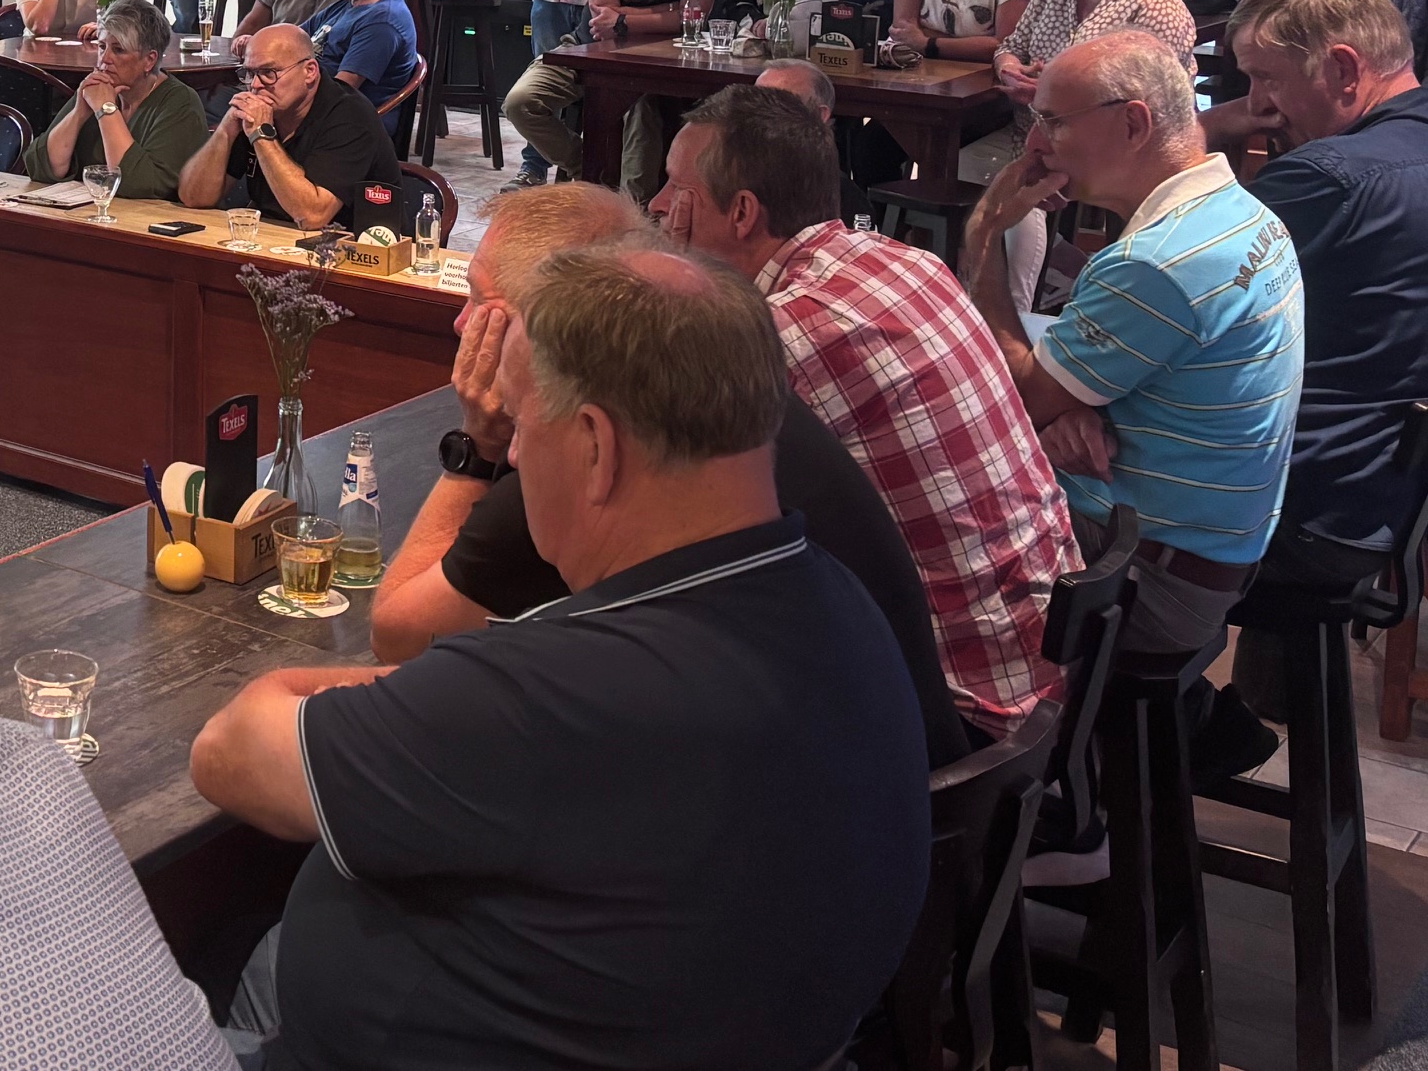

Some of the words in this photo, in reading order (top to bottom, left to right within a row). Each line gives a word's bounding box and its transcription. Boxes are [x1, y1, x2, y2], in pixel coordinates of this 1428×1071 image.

[817, 52, 849, 66] TEXELS
[365, 188, 391, 201] TEXELS
[446, 262, 468, 272] Horlog
[441, 279, 468, 289] biljarten
[220, 414, 246, 434] TEXELS
[251, 532, 275, 559] TEX
